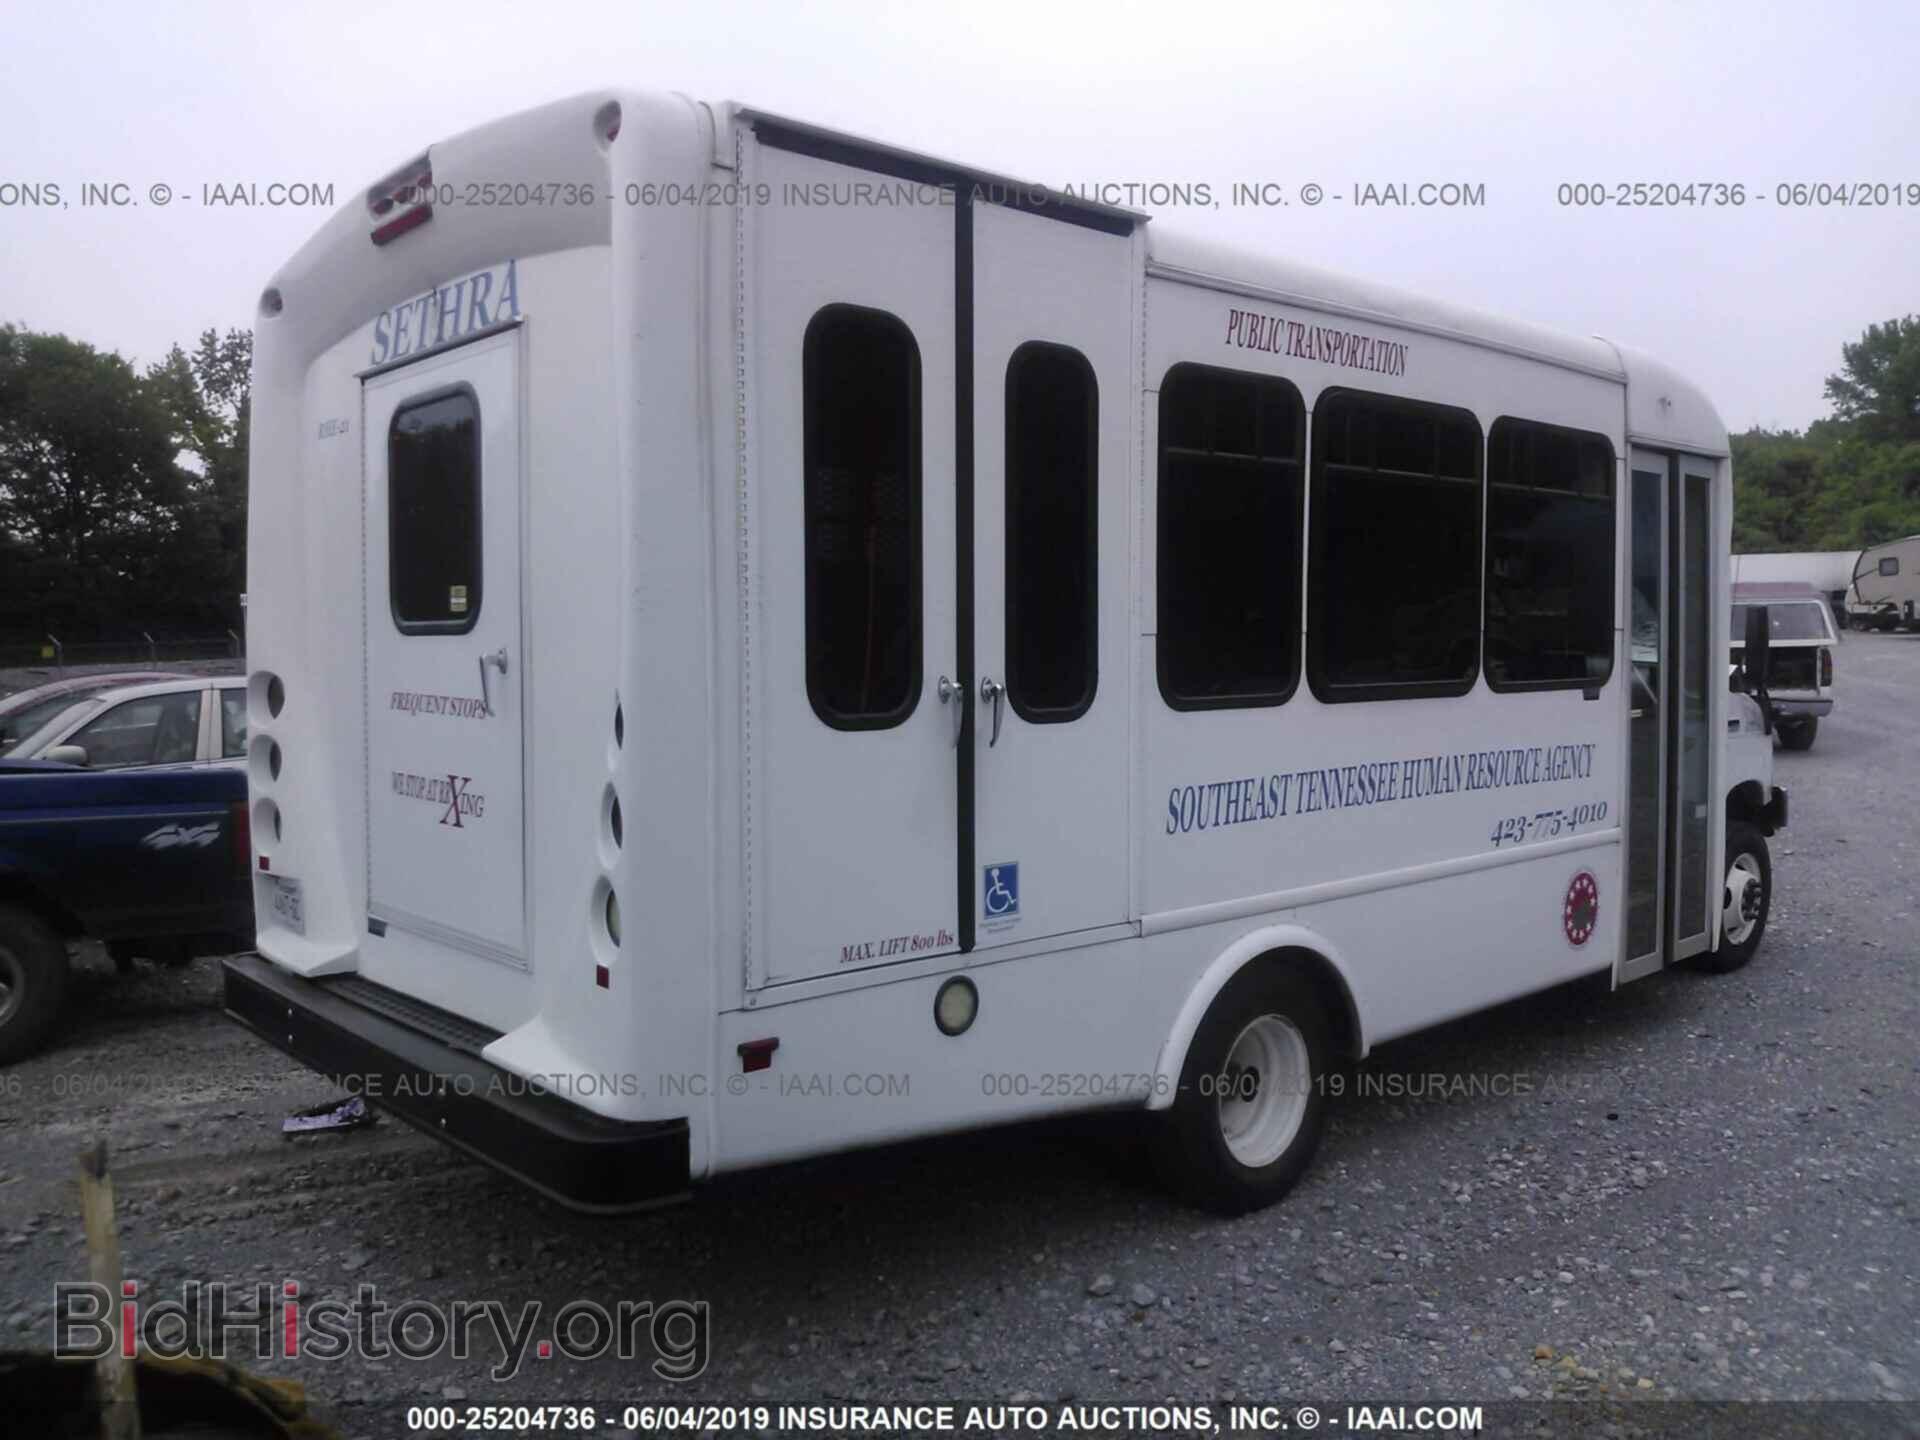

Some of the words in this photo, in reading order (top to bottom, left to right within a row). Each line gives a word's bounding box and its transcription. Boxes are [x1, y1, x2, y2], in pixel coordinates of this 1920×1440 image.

[370, 258, 521, 366] SETHRA
[1225, 309, 1285, 354] PUBLIC
[1285, 321, 1409, 377] TRANSPORTATION
[390, 691, 450, 717] FREQUENT
[449, 697, 487, 720] STOPS
[1166, 774, 1293, 835] SOUTHEAST
[1295, 762, 1400, 815] TENNESSEE
[1401, 755, 1465, 799] HUMAN
[1465, 748, 1543, 791] RESOURCE
[1543, 743, 1596, 782] AGENCY
[1491, 801, 1608, 847] 423-775-4010
[840, 941, 876, 963] MAX.
[878, 936, 908, 957] LIFT
[910, 934, 935, 951] 800
[936, 929, 955, 948] lbs
